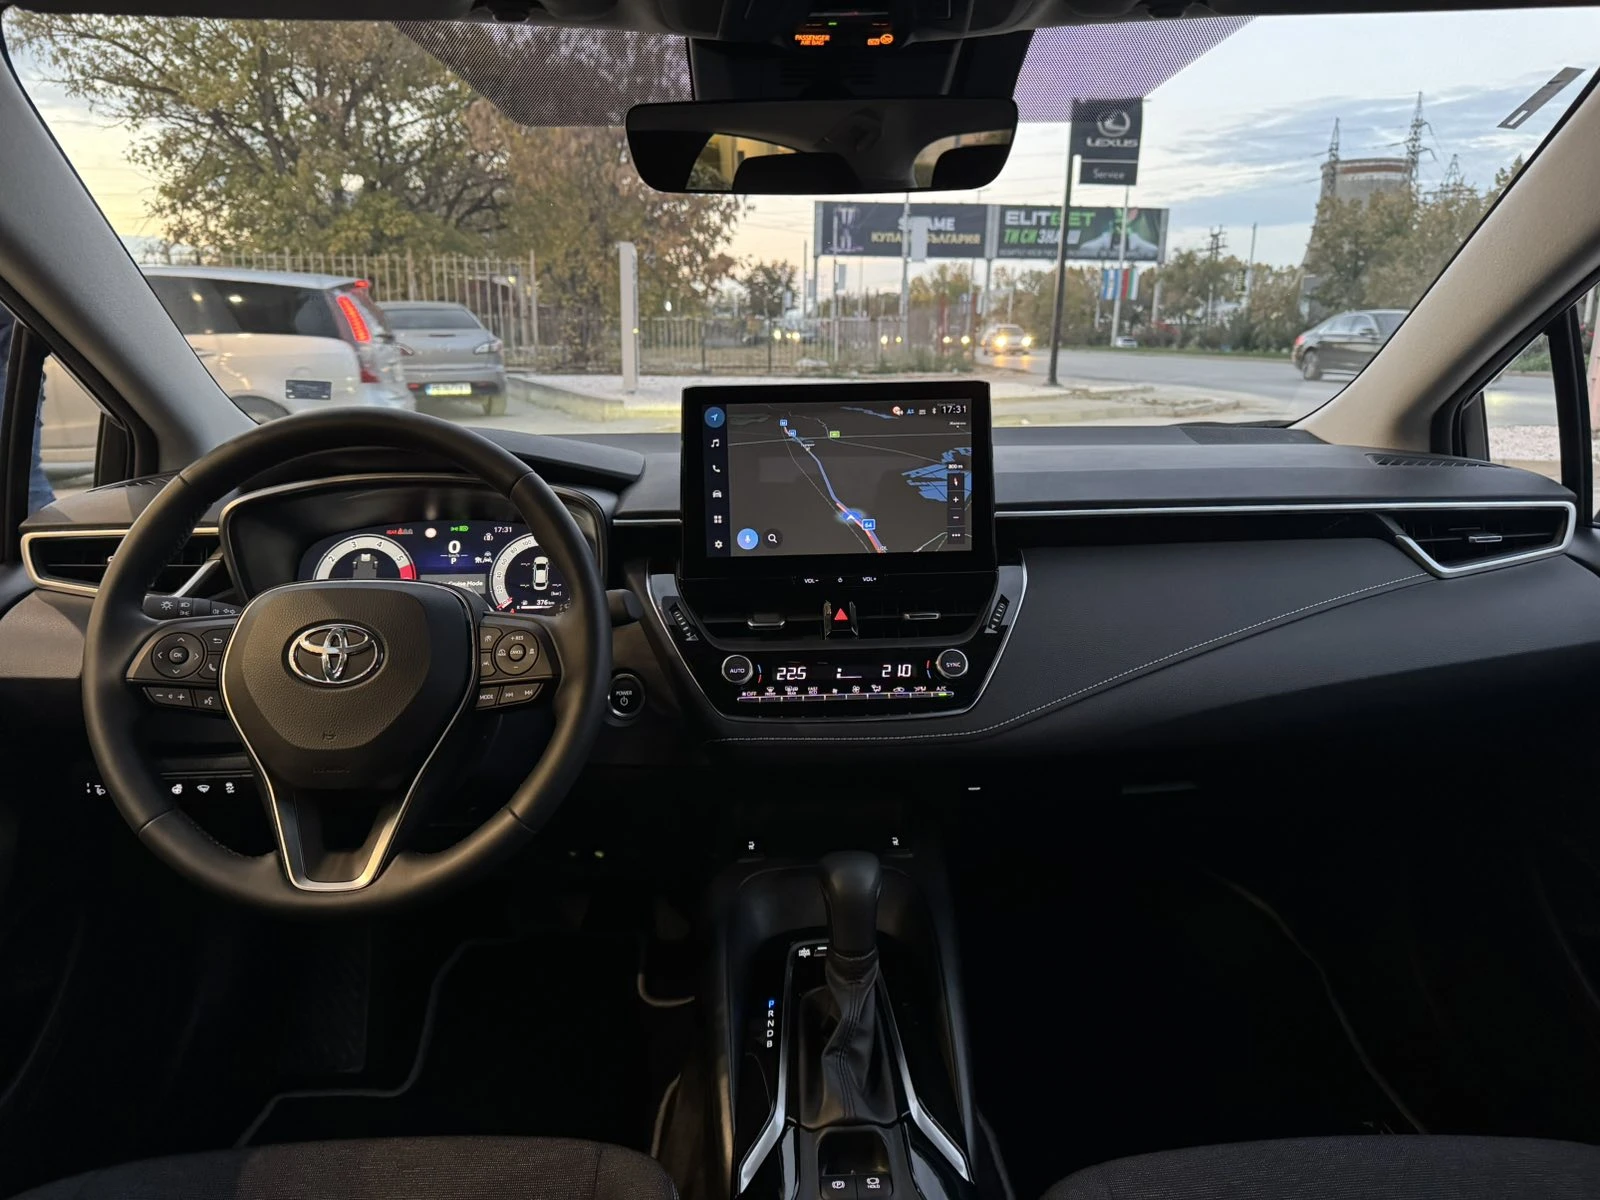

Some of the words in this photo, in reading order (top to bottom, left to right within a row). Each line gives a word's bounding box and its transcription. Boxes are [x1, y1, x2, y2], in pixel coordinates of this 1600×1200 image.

[1086, 137, 1138, 148] LEXUS
[1093, 168, 1125, 179] Service
[943, 405, 967, 414] 17:31
[448, 540, 461, 554] 0
[768, 1000, 775, 1009] P
[767, 1009, 774, 1018] R
[767, 1019, 775, 1028] N
[766, 1029, 774, 1038] D
[766, 1040, 773, 1049] B
